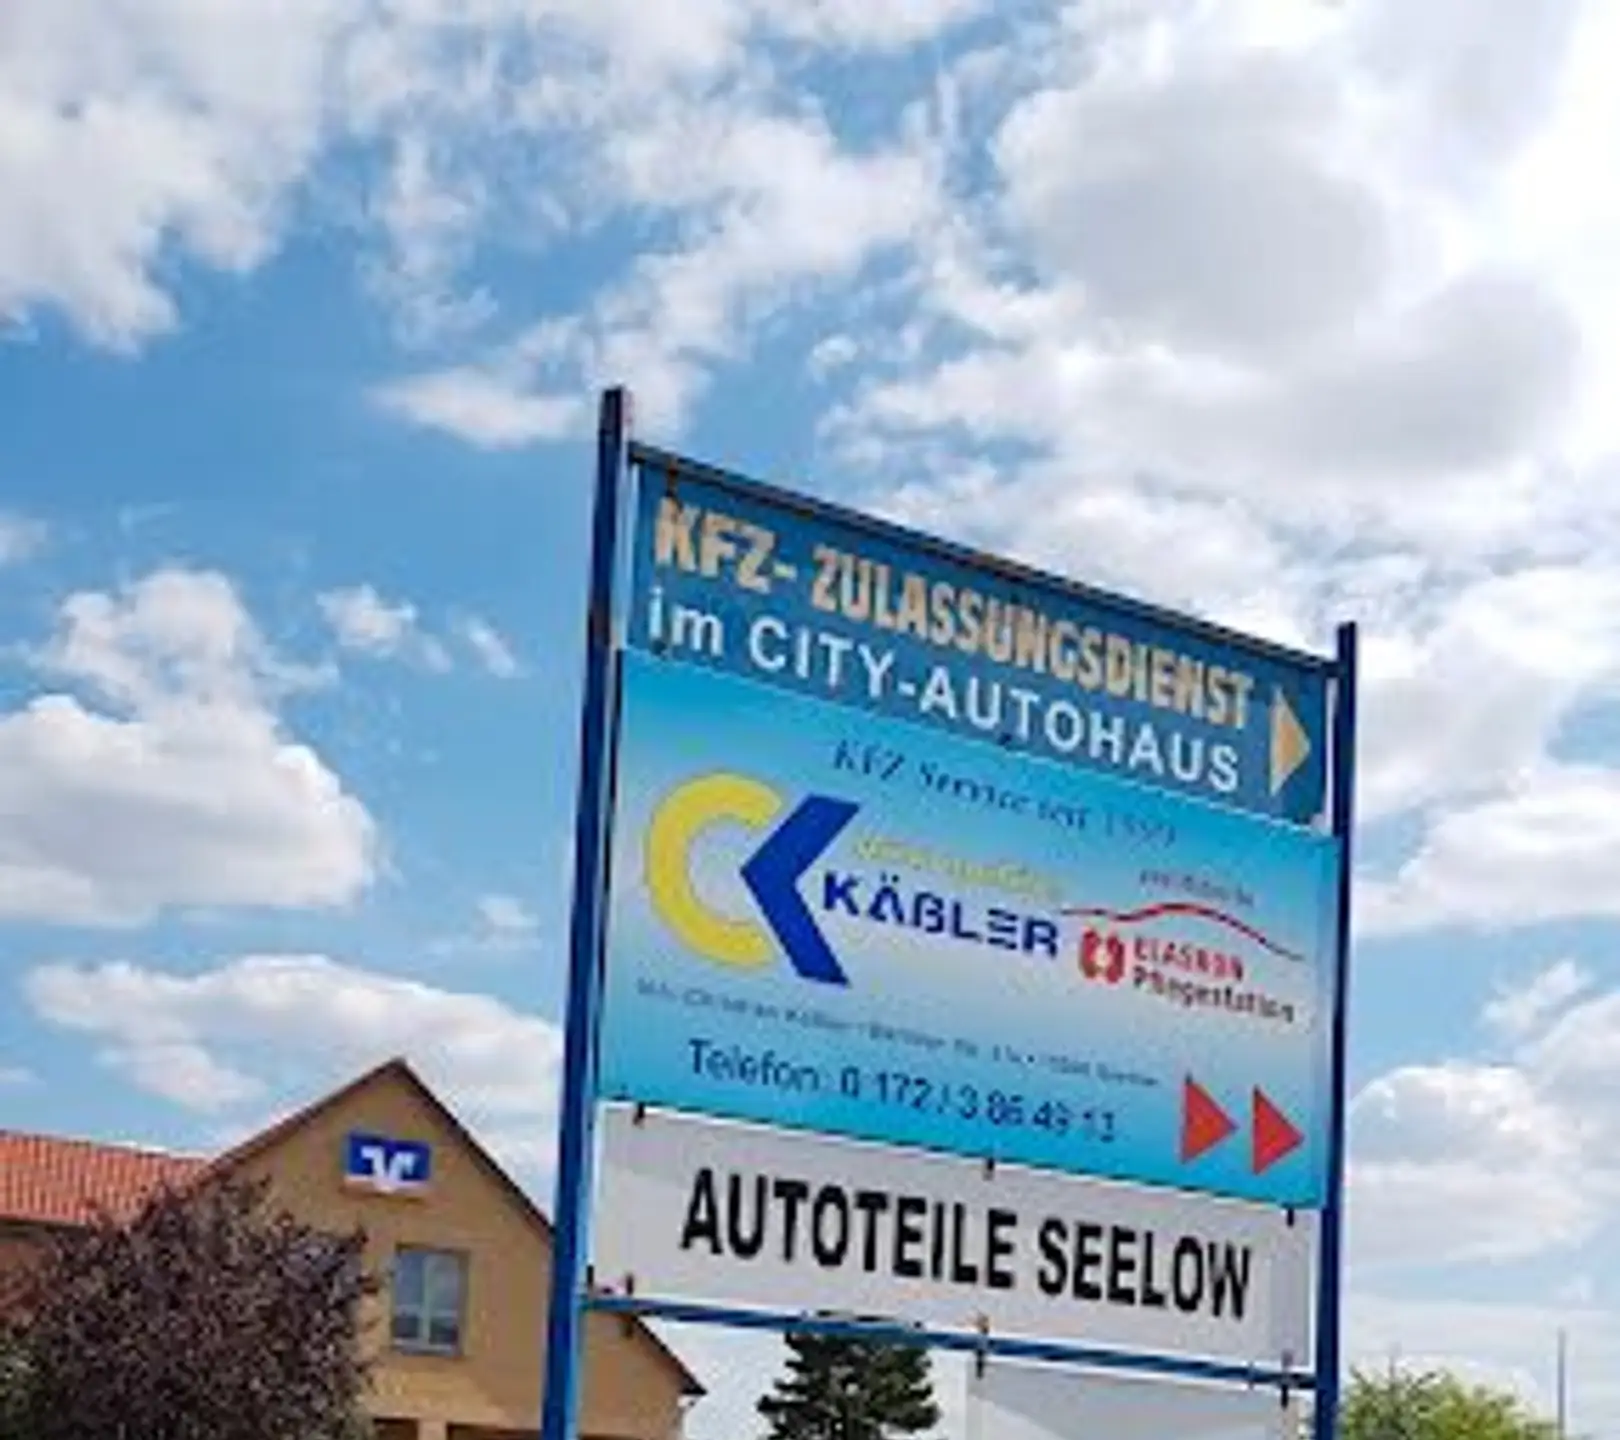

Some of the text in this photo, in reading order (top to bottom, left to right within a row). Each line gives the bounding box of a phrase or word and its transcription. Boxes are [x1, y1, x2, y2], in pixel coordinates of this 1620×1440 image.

[648, 587, 1239, 793] im CITY-AUTOHAUS
[654, 497, 1254, 728] KFZ- ZULASSUNGSDIENST
[680, 1168, 1252, 1320] AUTOTEILE SEELOW
